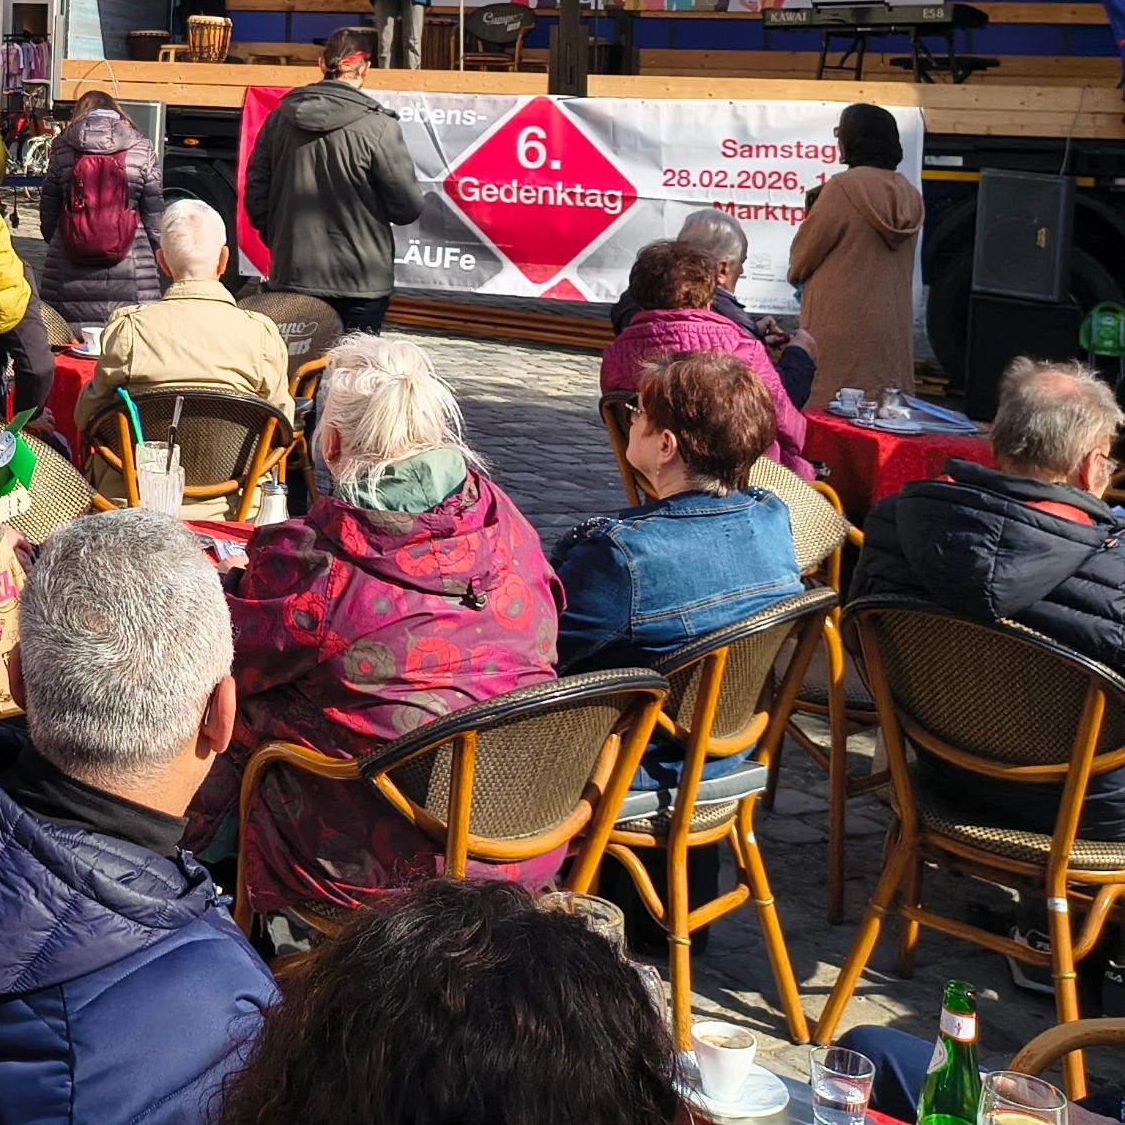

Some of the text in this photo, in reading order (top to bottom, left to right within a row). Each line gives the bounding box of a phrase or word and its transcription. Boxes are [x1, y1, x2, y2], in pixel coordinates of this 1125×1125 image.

[770, 11, 808, 22] KAWAI
[516, 126, 561, 170] 6.
[721, 139, 837, 164] Samstag
[662, 169, 806, 194] 28.02.2026,
[458, 176, 623, 214] Gedenktag
[712, 201, 810, 225] Marktp
